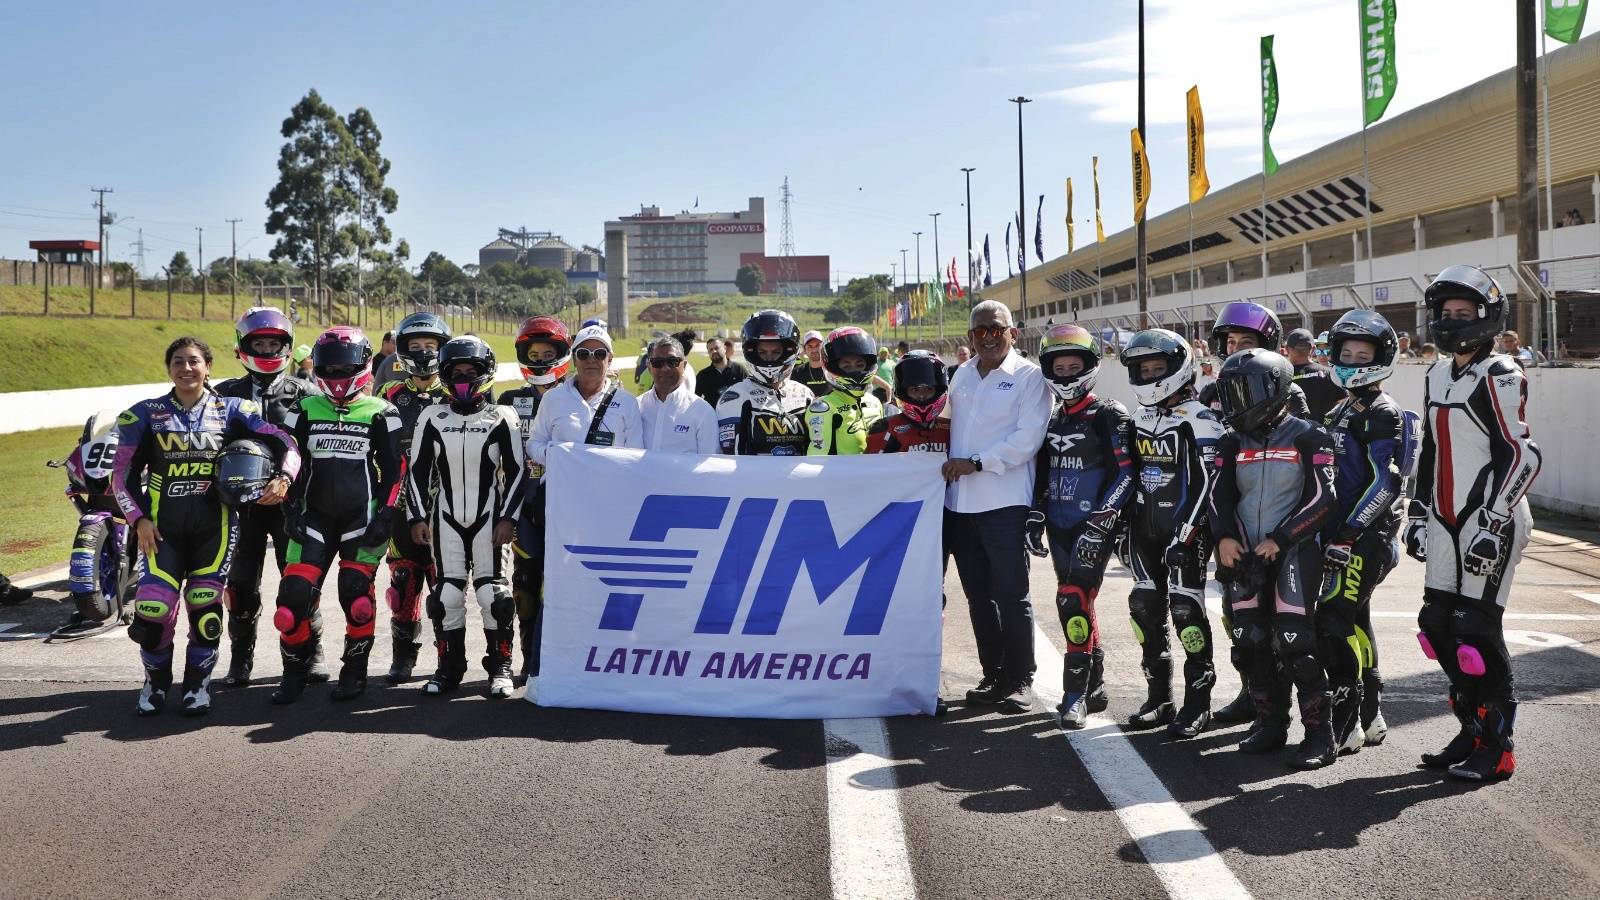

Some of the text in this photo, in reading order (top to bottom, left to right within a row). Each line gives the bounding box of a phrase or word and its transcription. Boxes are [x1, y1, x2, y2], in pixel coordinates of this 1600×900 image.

[709, 224, 763, 232] COOPAVEL
[310, 423, 369, 433] MIRANDA
[315, 438, 366, 451] MOTORACE
[85, 443, 117, 469] 99
[1236, 450, 1298, 462] LS2
[168, 462, 214, 476] M78
[168, 480, 213, 496] GP3
[1356, 488, 1390, 523] YAMALUBE
[563, 494, 924, 636] FIM
[1344, 555, 1363, 602] M78
[192, 591, 215, 599] M78
[139, 603, 161, 613] M78
[584, 646, 871, 680] LATIN AMERICA
